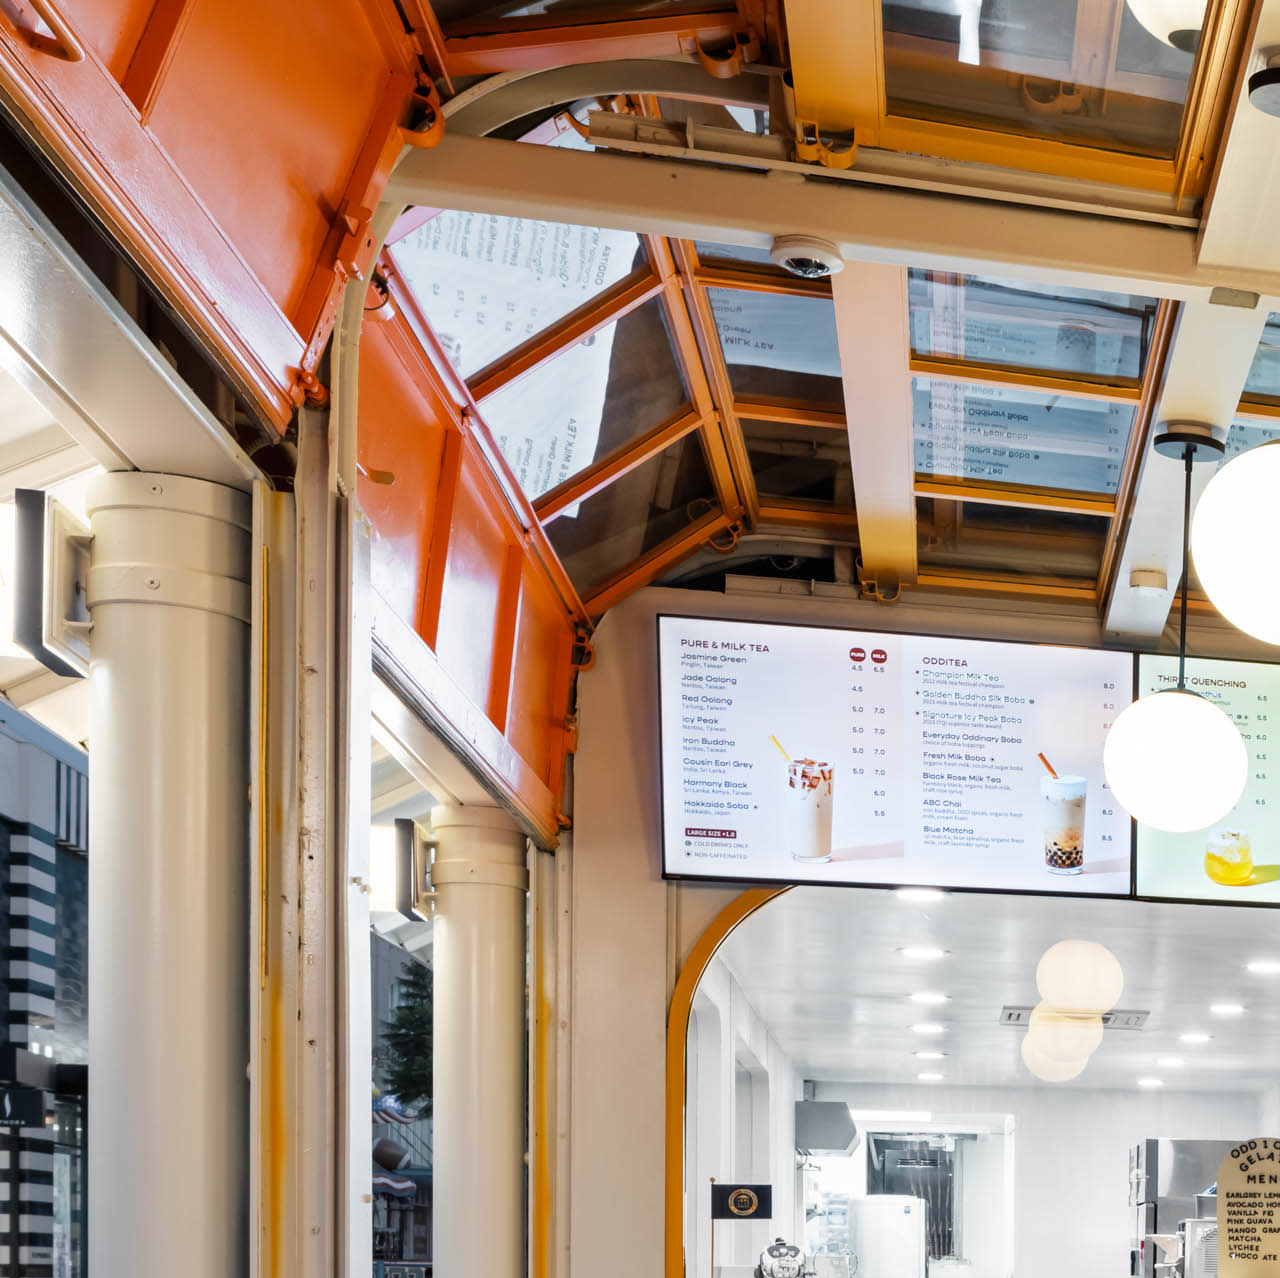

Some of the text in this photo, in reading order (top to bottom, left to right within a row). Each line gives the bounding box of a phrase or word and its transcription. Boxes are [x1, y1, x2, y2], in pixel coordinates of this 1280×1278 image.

[681, 639, 770, 652] PURE & MILK TEA
[681, 652, 747, 663] Jasmine Green
[922, 656, 968, 667] ODDITEA
[681, 674, 737, 685] Jade Oolong
[922, 670, 965, 679] Champion
[984, 674, 999, 682] Tea
[1158, 675, 1247, 688] THIRT QUENCHING
[682, 694, 733, 706] Red Oolong
[922, 690, 1025, 704] Golden Buddha Silk Boba
[697, 716, 719, 724] Peak
[922, 711, 962, 721] Signature
[978, 714, 998, 722] Peak
[1001, 716, 1023, 724] Boba
[701, 738, 735, 746] Buddha
[922, 731, 1022, 744] Everyday Oddinary Boba
[923, 752, 946, 760] Fresh
[964, 754, 986, 762] Boba
[683, 757, 753, 769] Cousin Earl Grey
[922, 772, 944, 780] Black
[947, 773, 967, 781] Rose
[684, 779, 748, 789] Harmony Black
[684, 800, 749, 810] Hokkaido Soba
[923, 799, 941, 807] ABC
[923, 825, 974, 835] Blue Matcha
[1230, 1140, 1257, 1158] ODD
[1229, 1244, 1260, 1252] LYCHEE
